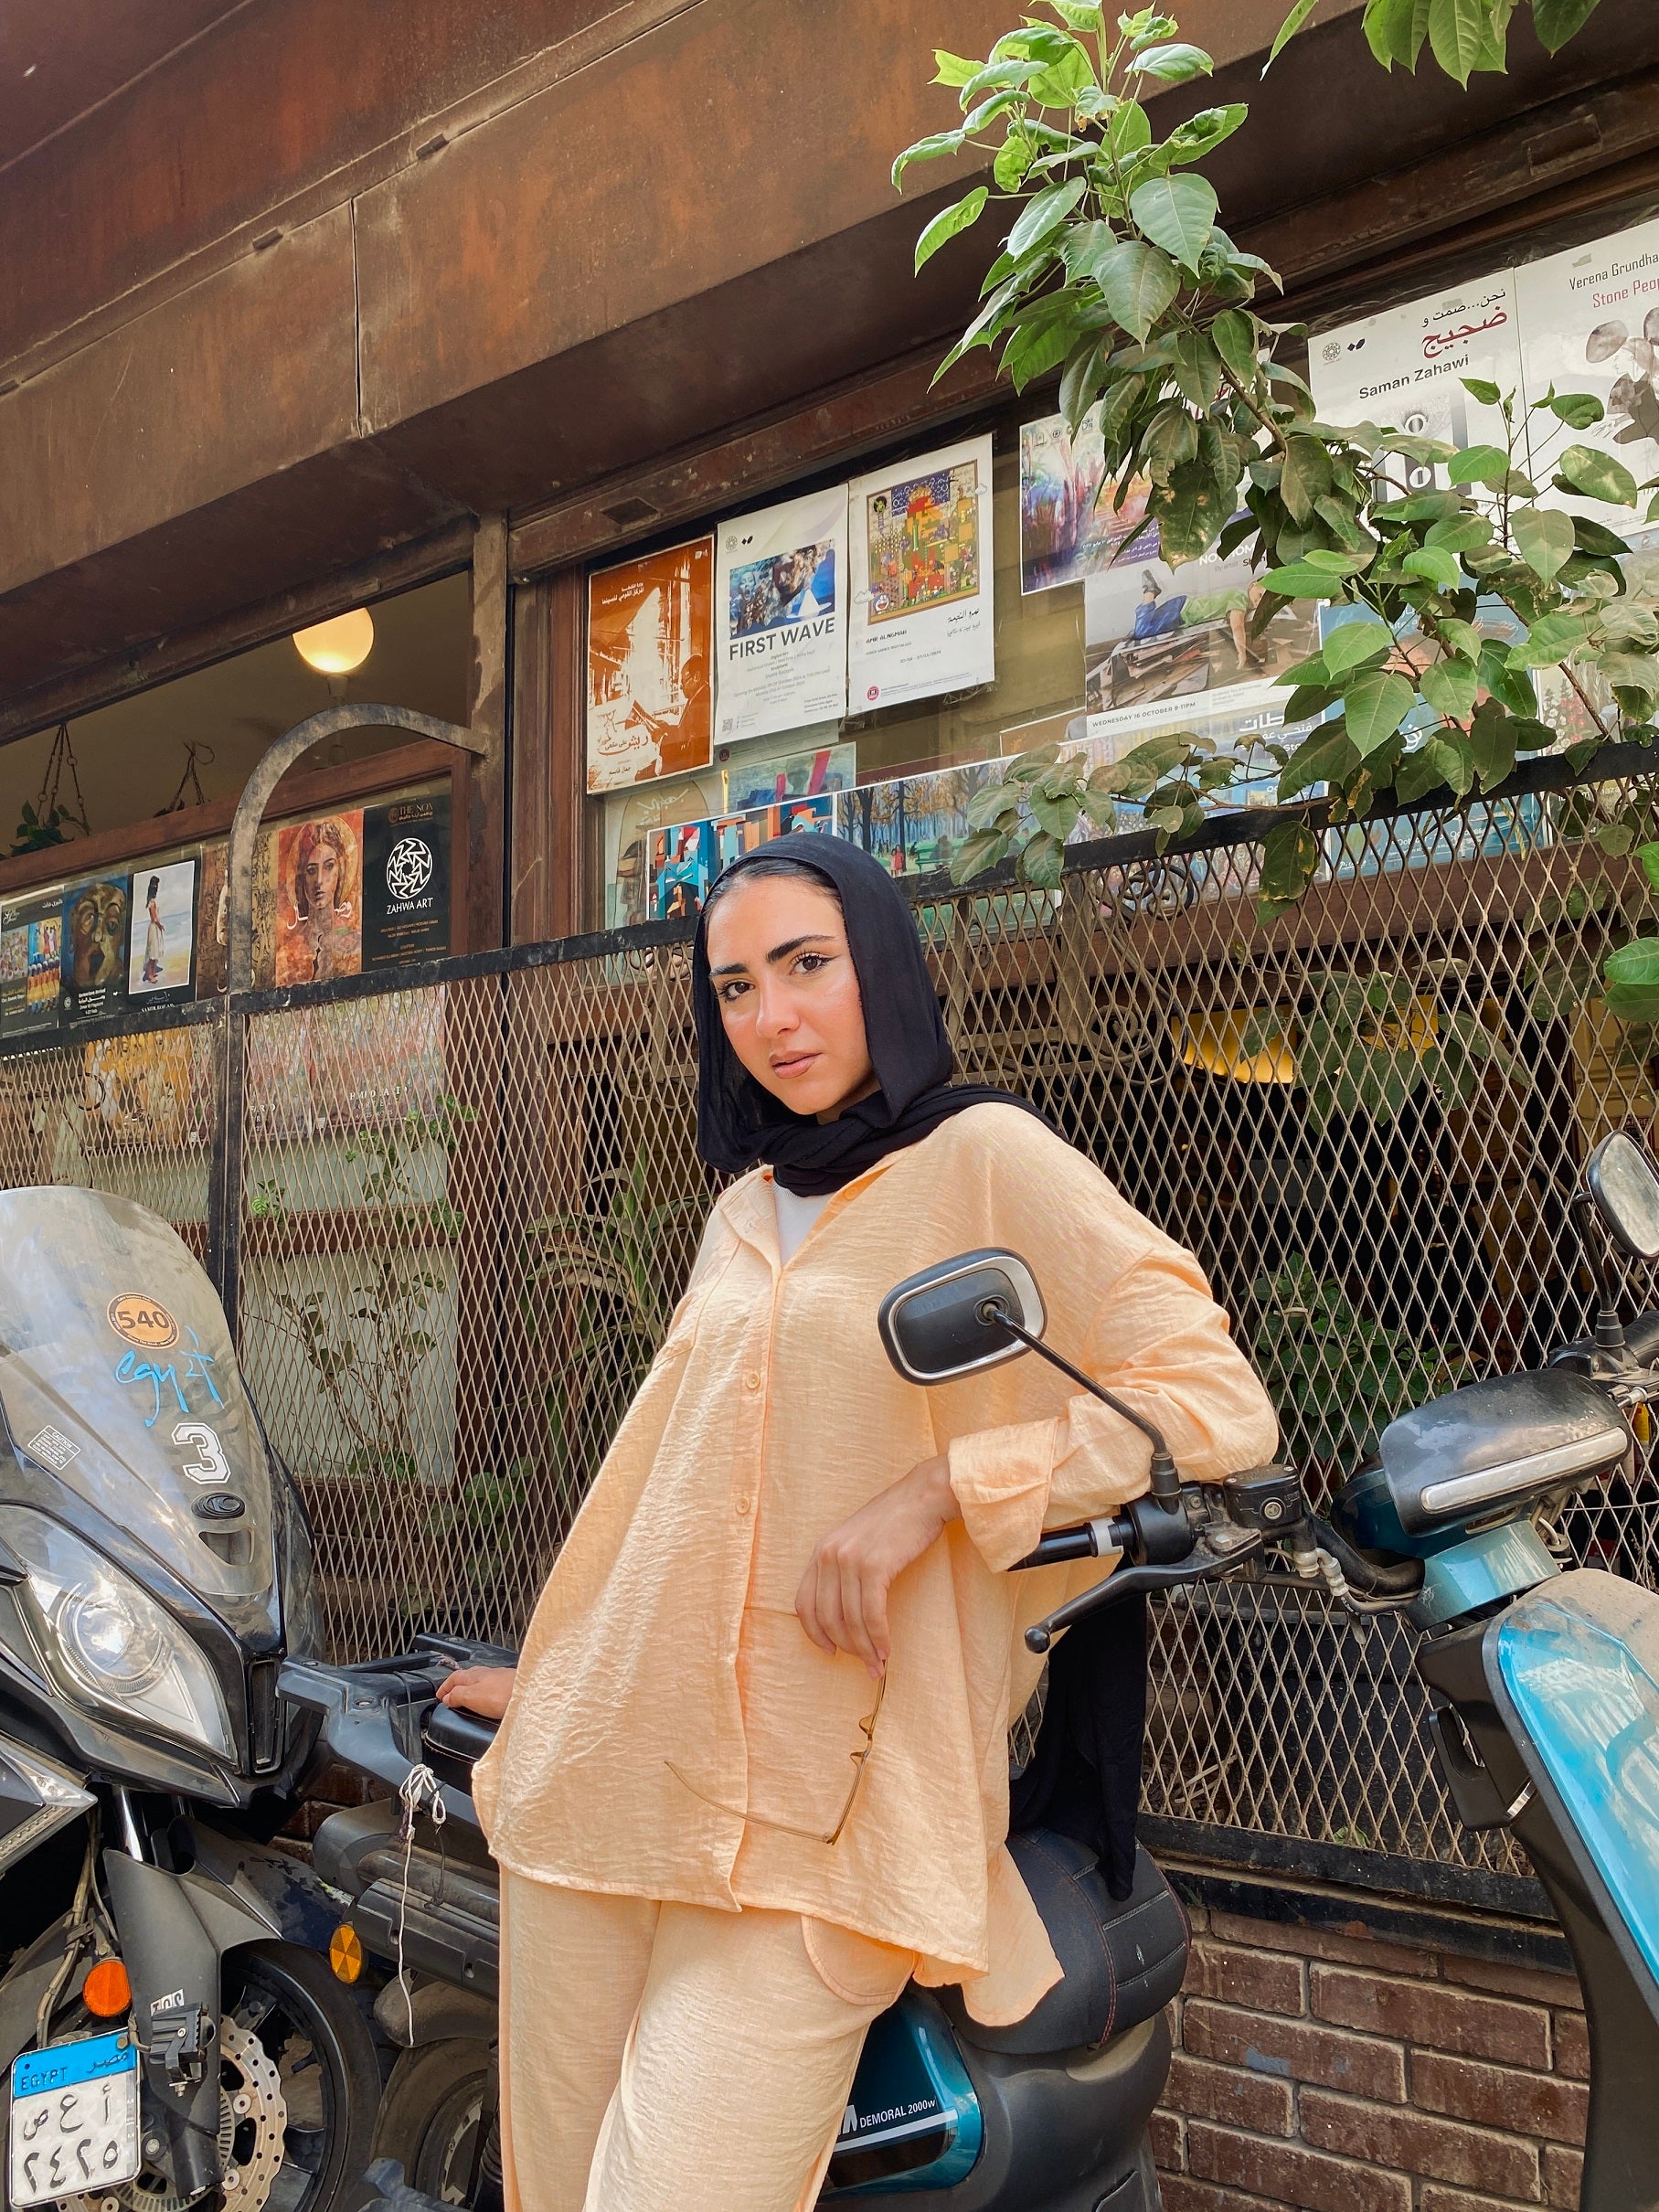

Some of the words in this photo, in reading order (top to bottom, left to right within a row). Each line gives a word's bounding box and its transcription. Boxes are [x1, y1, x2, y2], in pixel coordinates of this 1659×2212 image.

[1569, 271, 1609, 291] Verena
[1592, 292, 1629, 308] Stone
[1632, 278, 1659, 295] Peo
[1420, 305, 1508, 359] ضجيج
[1421, 316, 1430, 328] و
[1359, 376, 1410, 399] Saman
[1414, 354, 1470, 382] Zahawi
[729, 633, 777, 661] FIRST
[781, 617, 835, 646] WAVE
[1092, 715, 1133, 728] WEDNESDAY
[1142, 707, 1173, 718] OCTOBER
[387, 900, 415, 914] ZAHWA
[416, 897, 434, 909] ART
[117, 1310, 170, 1329] 540
[52, 1431, 73, 1449] CAUTION
[171, 1422, 231, 1484] 3
[86, 2051, 130, 2074] مصر
[21, 2066, 69, 2091] EGYPT
[860, 2105, 907, 2129] DEMORAL
[909, 2099, 936, 2114] 2000w
